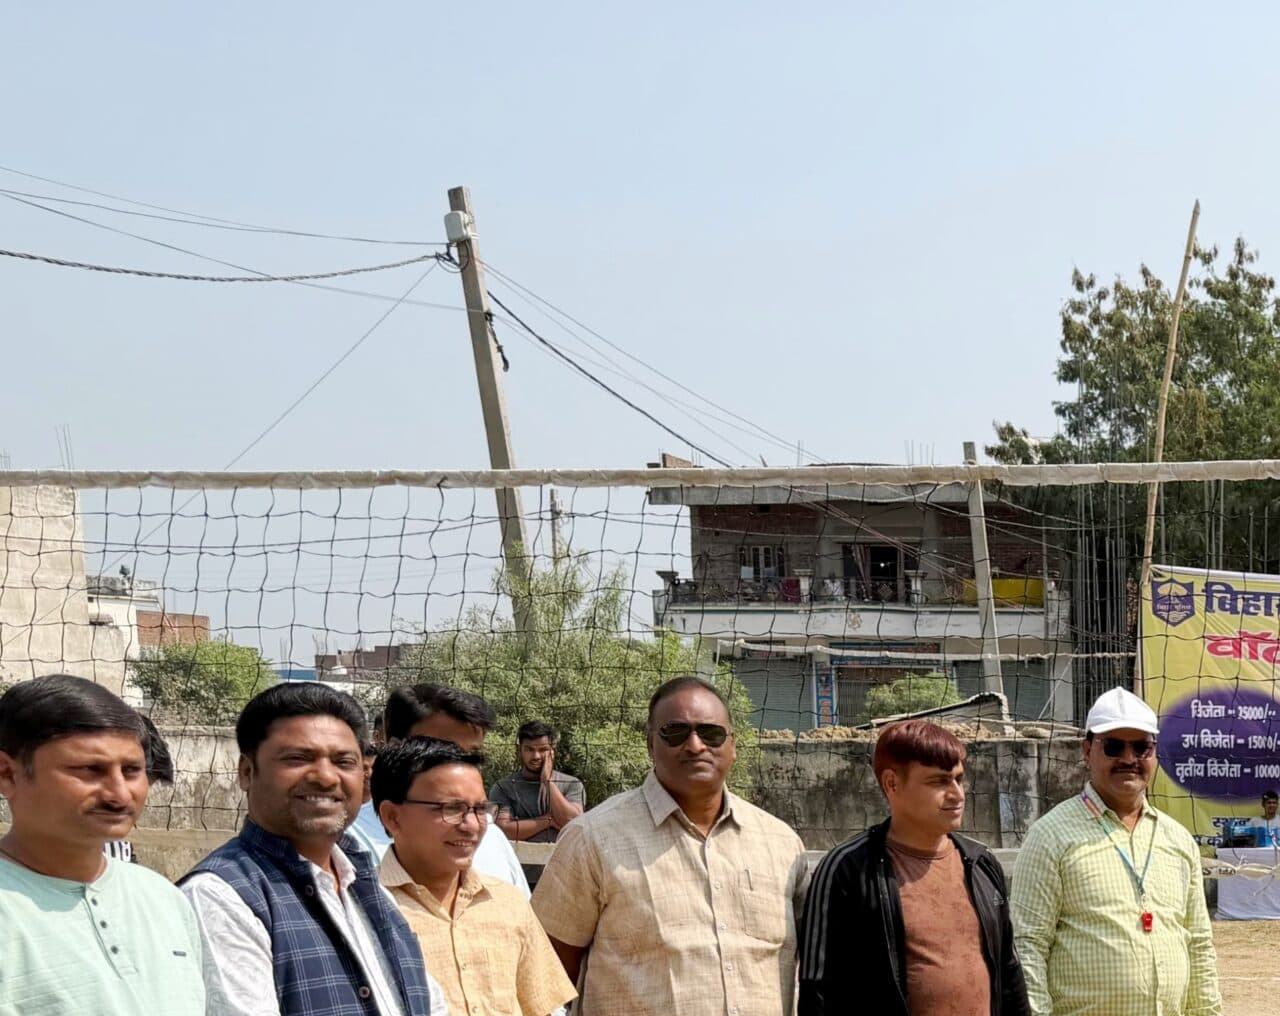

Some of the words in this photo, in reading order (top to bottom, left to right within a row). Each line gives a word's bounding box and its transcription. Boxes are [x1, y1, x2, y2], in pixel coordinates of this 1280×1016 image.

[1201, 729, 1235, 749] विजेता
[1176, 758, 1205, 783] तृतीय
[1207, 760, 1241, 778] विजेता
